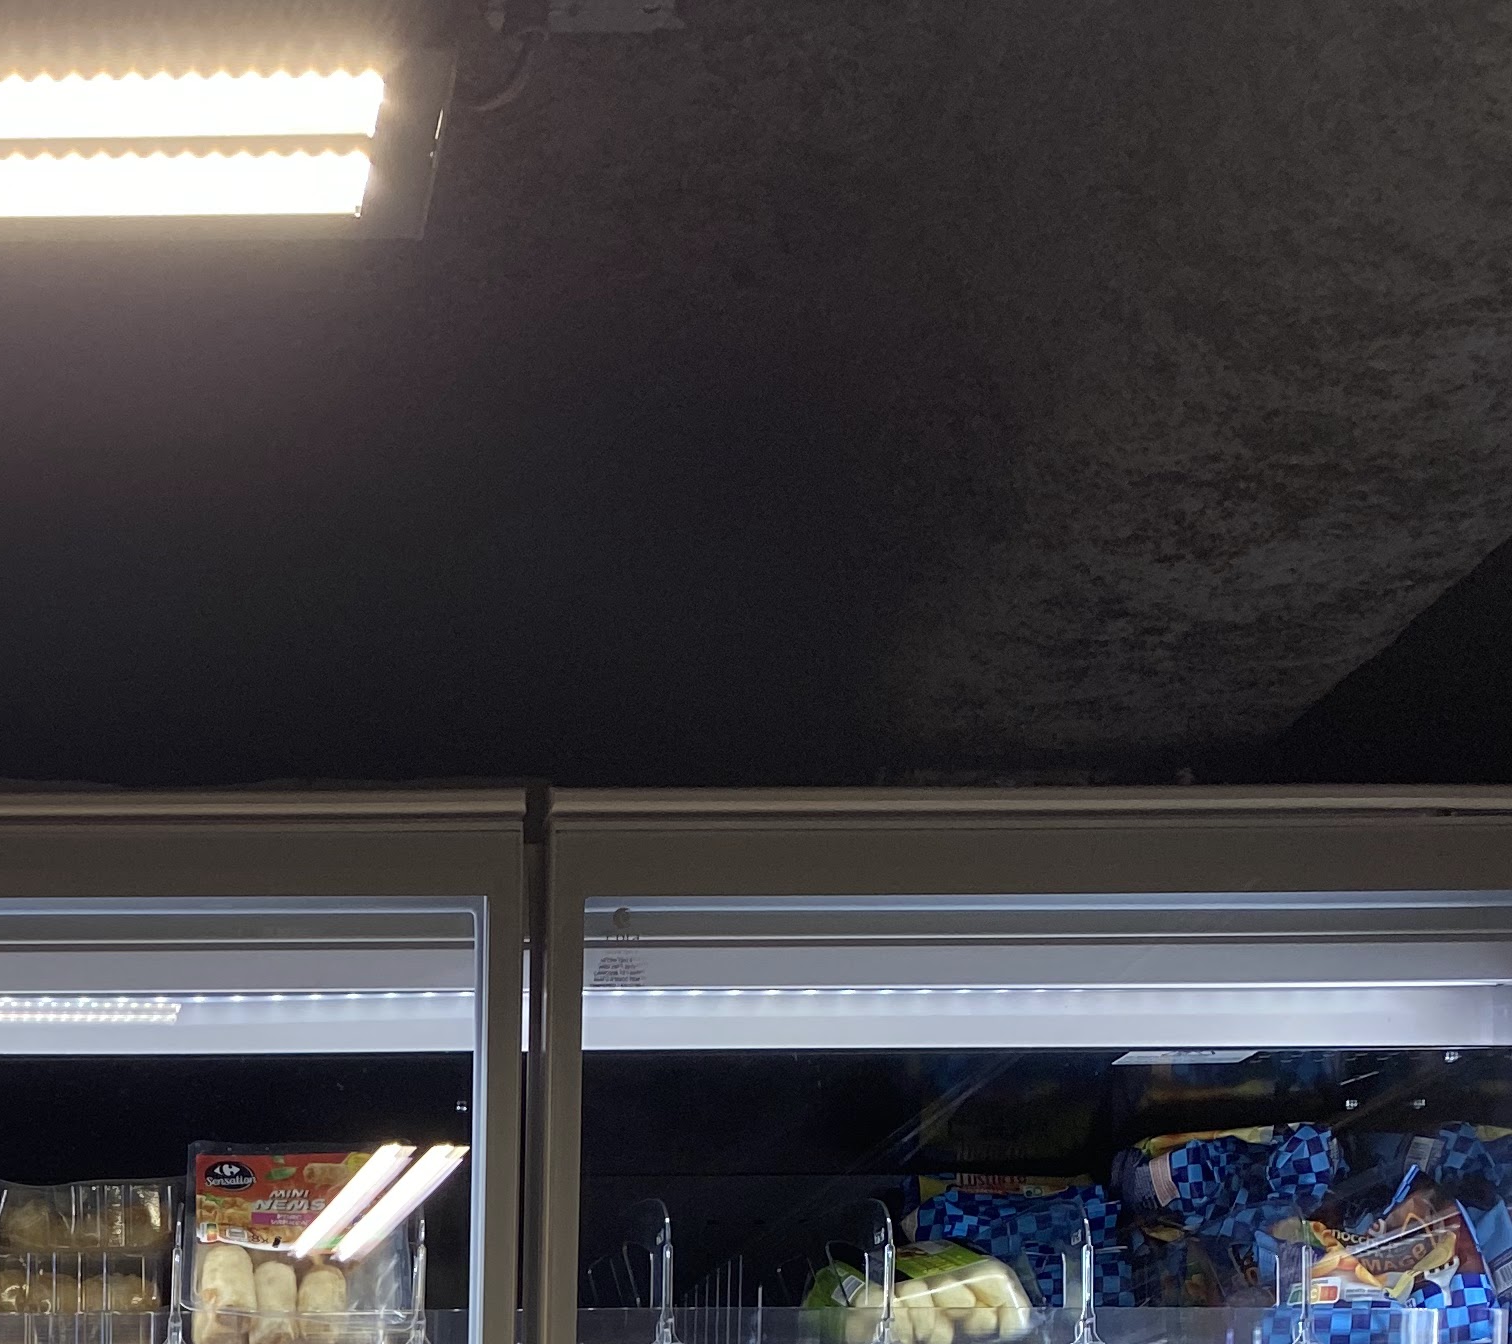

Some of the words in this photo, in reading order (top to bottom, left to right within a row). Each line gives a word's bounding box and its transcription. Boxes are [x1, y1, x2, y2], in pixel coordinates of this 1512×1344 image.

[204, 1173, 257, 1188] Sensation
[270, 1189, 309, 1200] MINI
[252, 1198, 325, 1212] NEMS
